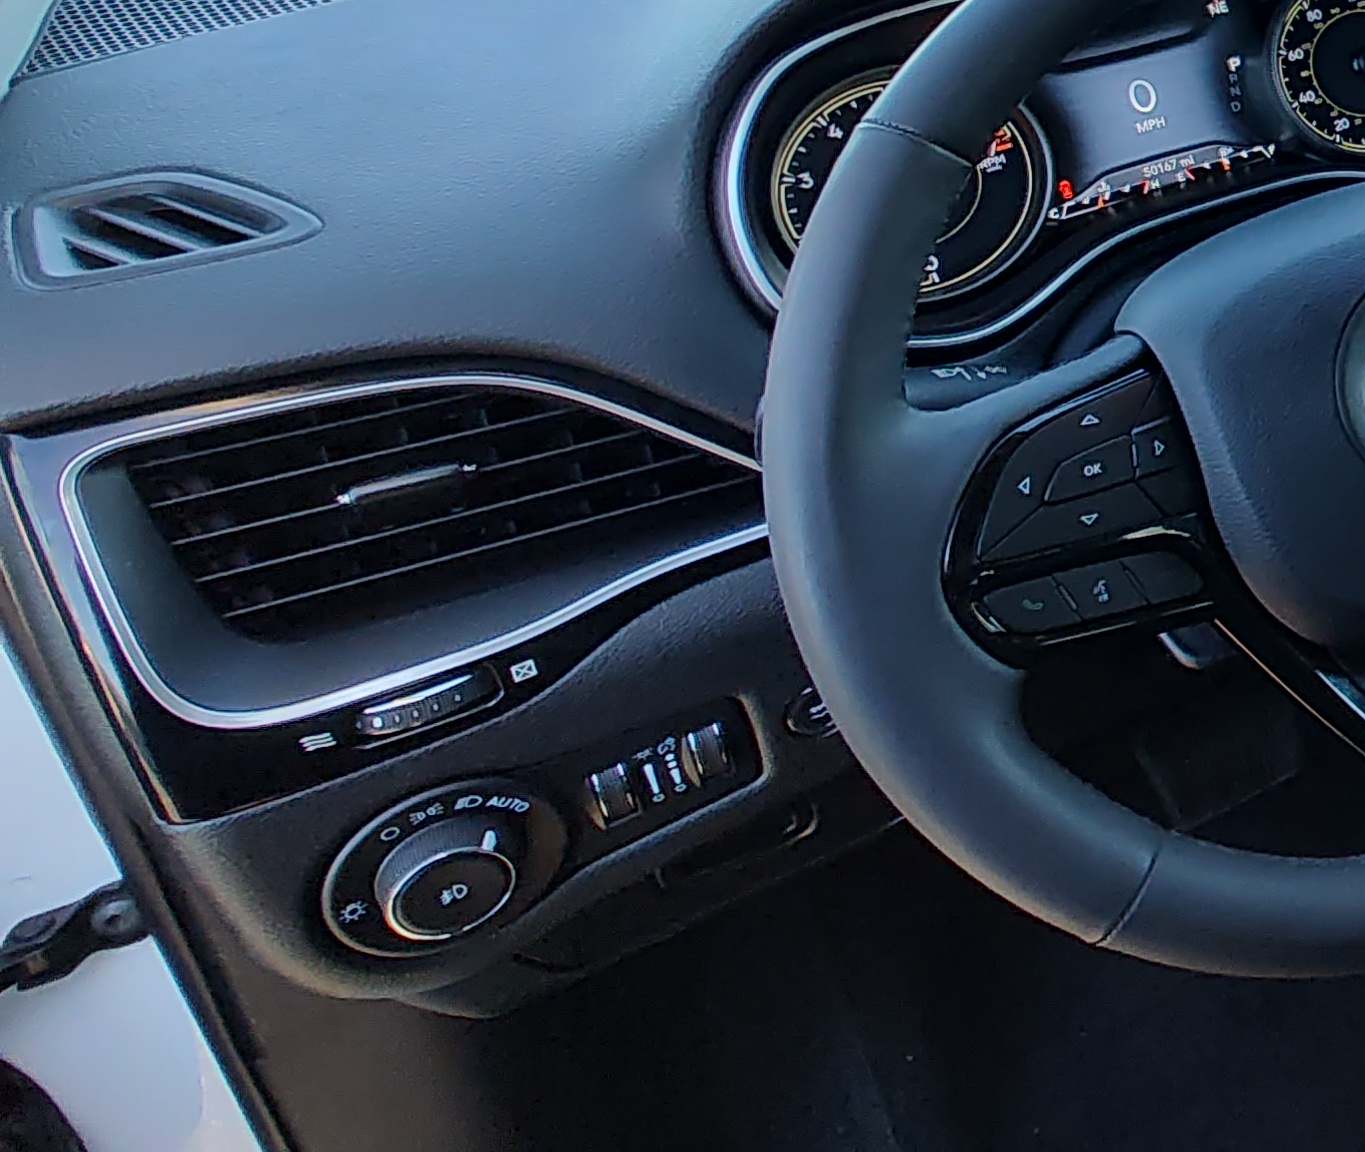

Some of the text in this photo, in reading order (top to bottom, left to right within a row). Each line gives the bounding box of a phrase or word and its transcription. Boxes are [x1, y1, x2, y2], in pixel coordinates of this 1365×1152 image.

[1206, 0, 1230, 17] NE
[1305, 8, 1323, 23] 80
[1287, 47, 1305, 62] 60
[1226, 55, 1242, 73] P
[1128, 79, 1158, 114] 0
[1299, 90, 1316, 104] 40
[1230, 101, 1242, 113] D
[1135, 115, 1167, 134] MPH
[1333, 116, 1350, 132] 20
[1142, 159, 1178, 179] 50167
[797, 171, 815, 189] 3
[1083, 462, 1103, 477] OK
[486, 794, 531, 813] AUTO
